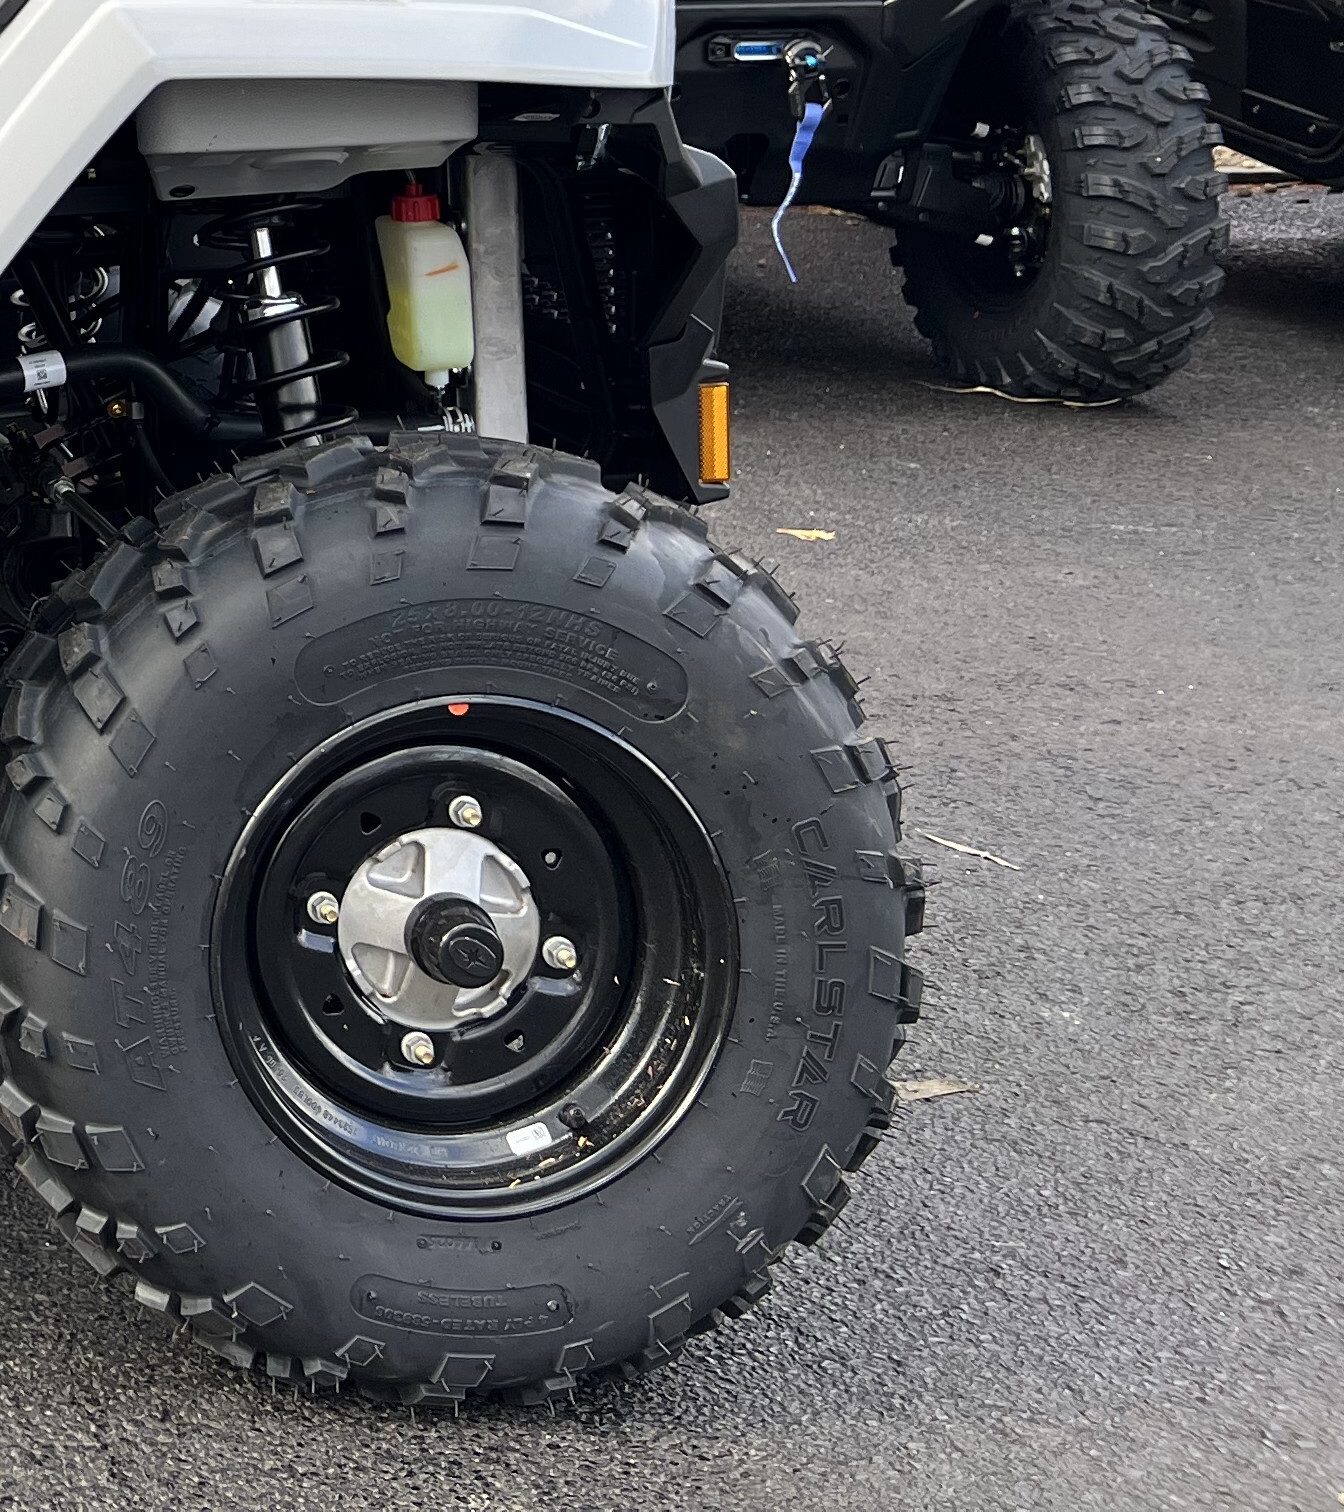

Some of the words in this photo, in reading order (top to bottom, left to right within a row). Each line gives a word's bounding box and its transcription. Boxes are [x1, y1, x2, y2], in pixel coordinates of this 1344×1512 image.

[543, 625, 620, 662] SERVICE
[775, 814, 848, 1136] CARLSTAR
[682, 1193, 731, 1236] TRACTION
[415, 1289, 507, 1307] TUBELESS
